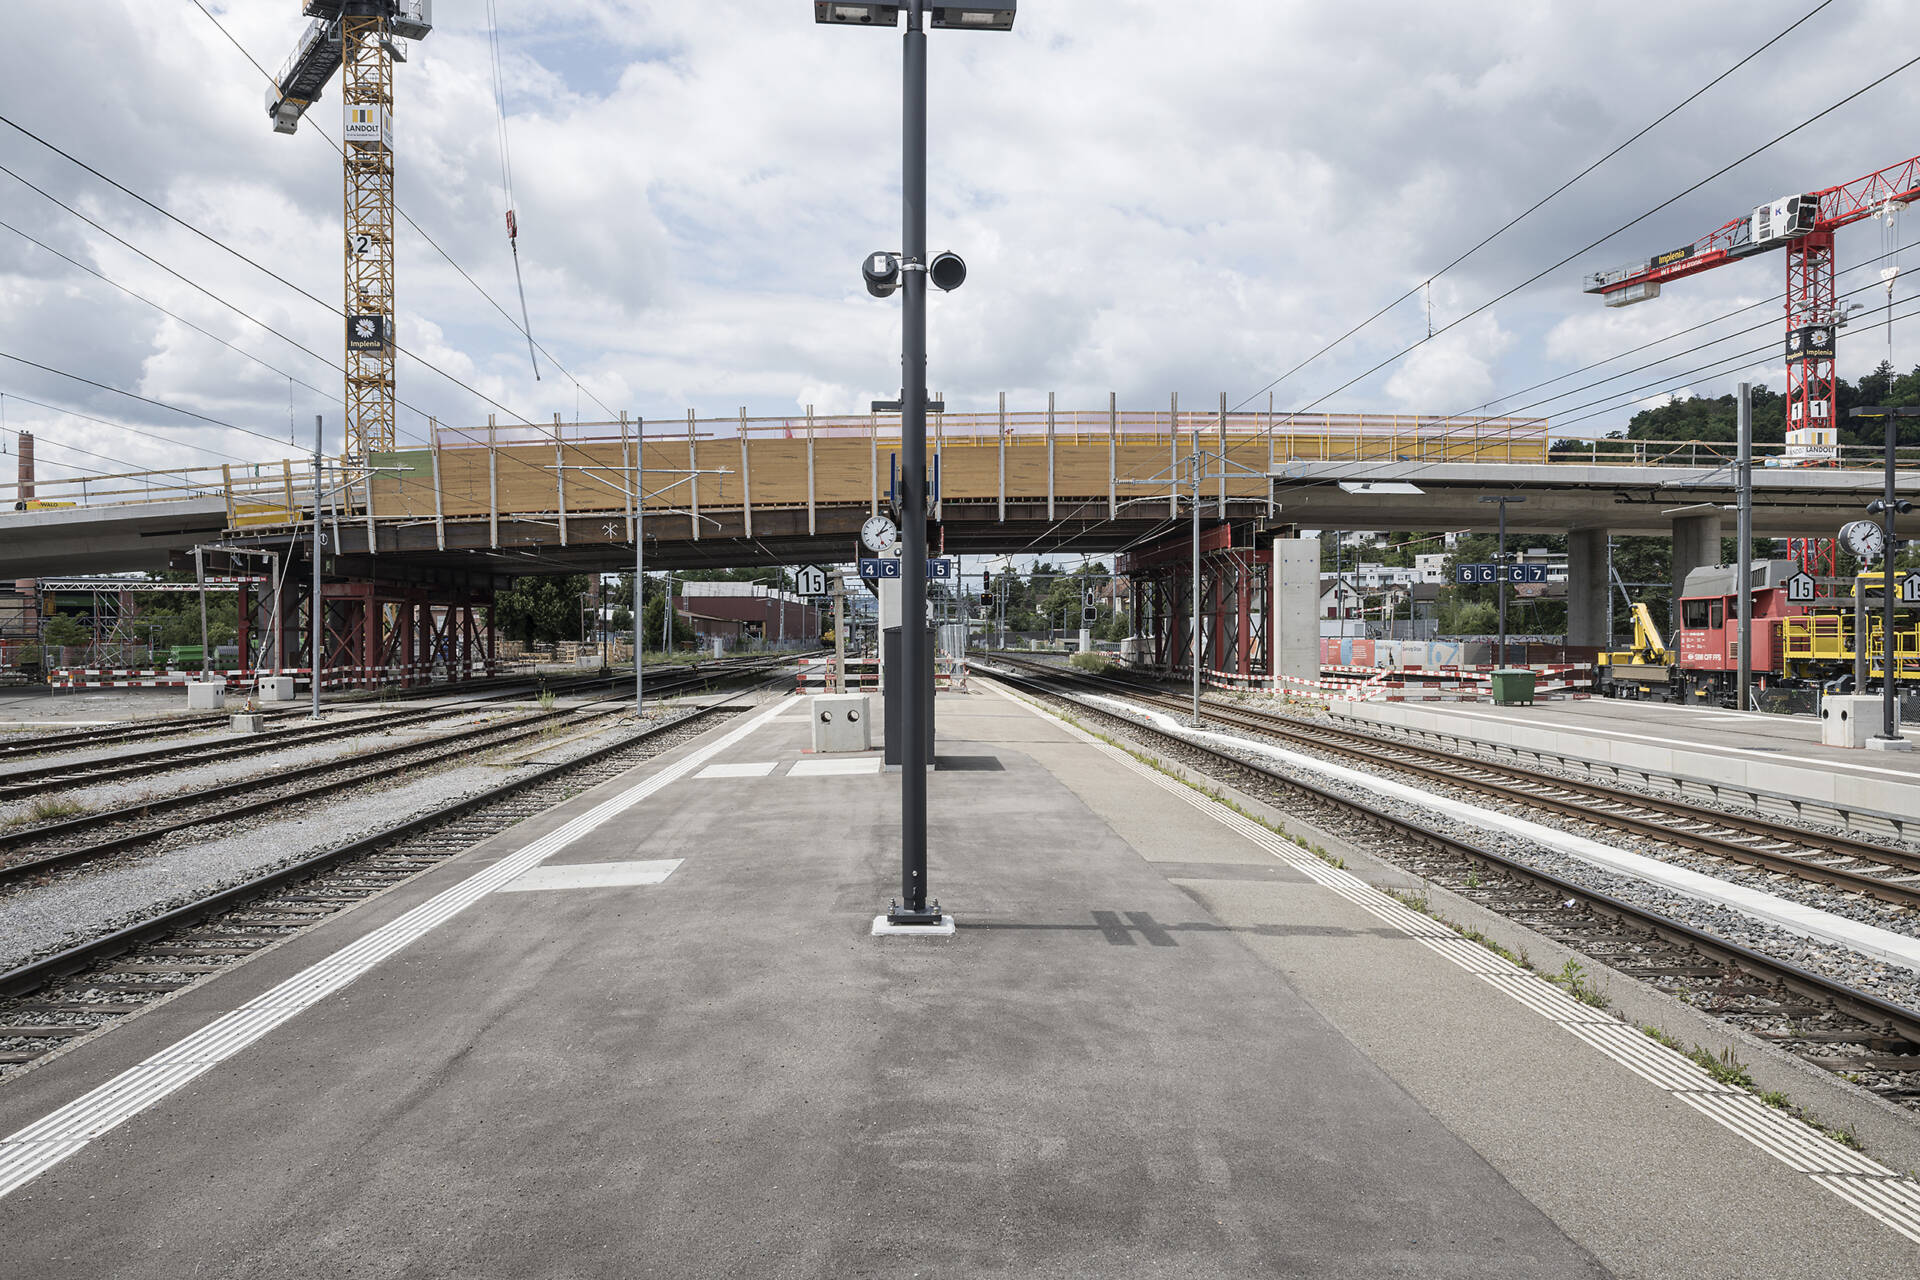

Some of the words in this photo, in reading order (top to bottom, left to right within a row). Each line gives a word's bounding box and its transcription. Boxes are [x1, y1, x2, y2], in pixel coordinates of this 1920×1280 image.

[357, 236, 369, 253] 2
[1794, 404, 1799, 418] 1
[1815, 402, 1821, 416] 1
[865, 564, 874, 576] 4
[885, 564, 895, 576] C
[936, 564, 945, 576] 5
[1463, 569, 1472, 580] 6
[1483, 569, 1492, 580] C
[1513, 569, 1522, 580] C
[1533, 569, 1542, 580] 7
[802, 570, 822, 592] 15
[1793, 578, 1810, 598] 15
